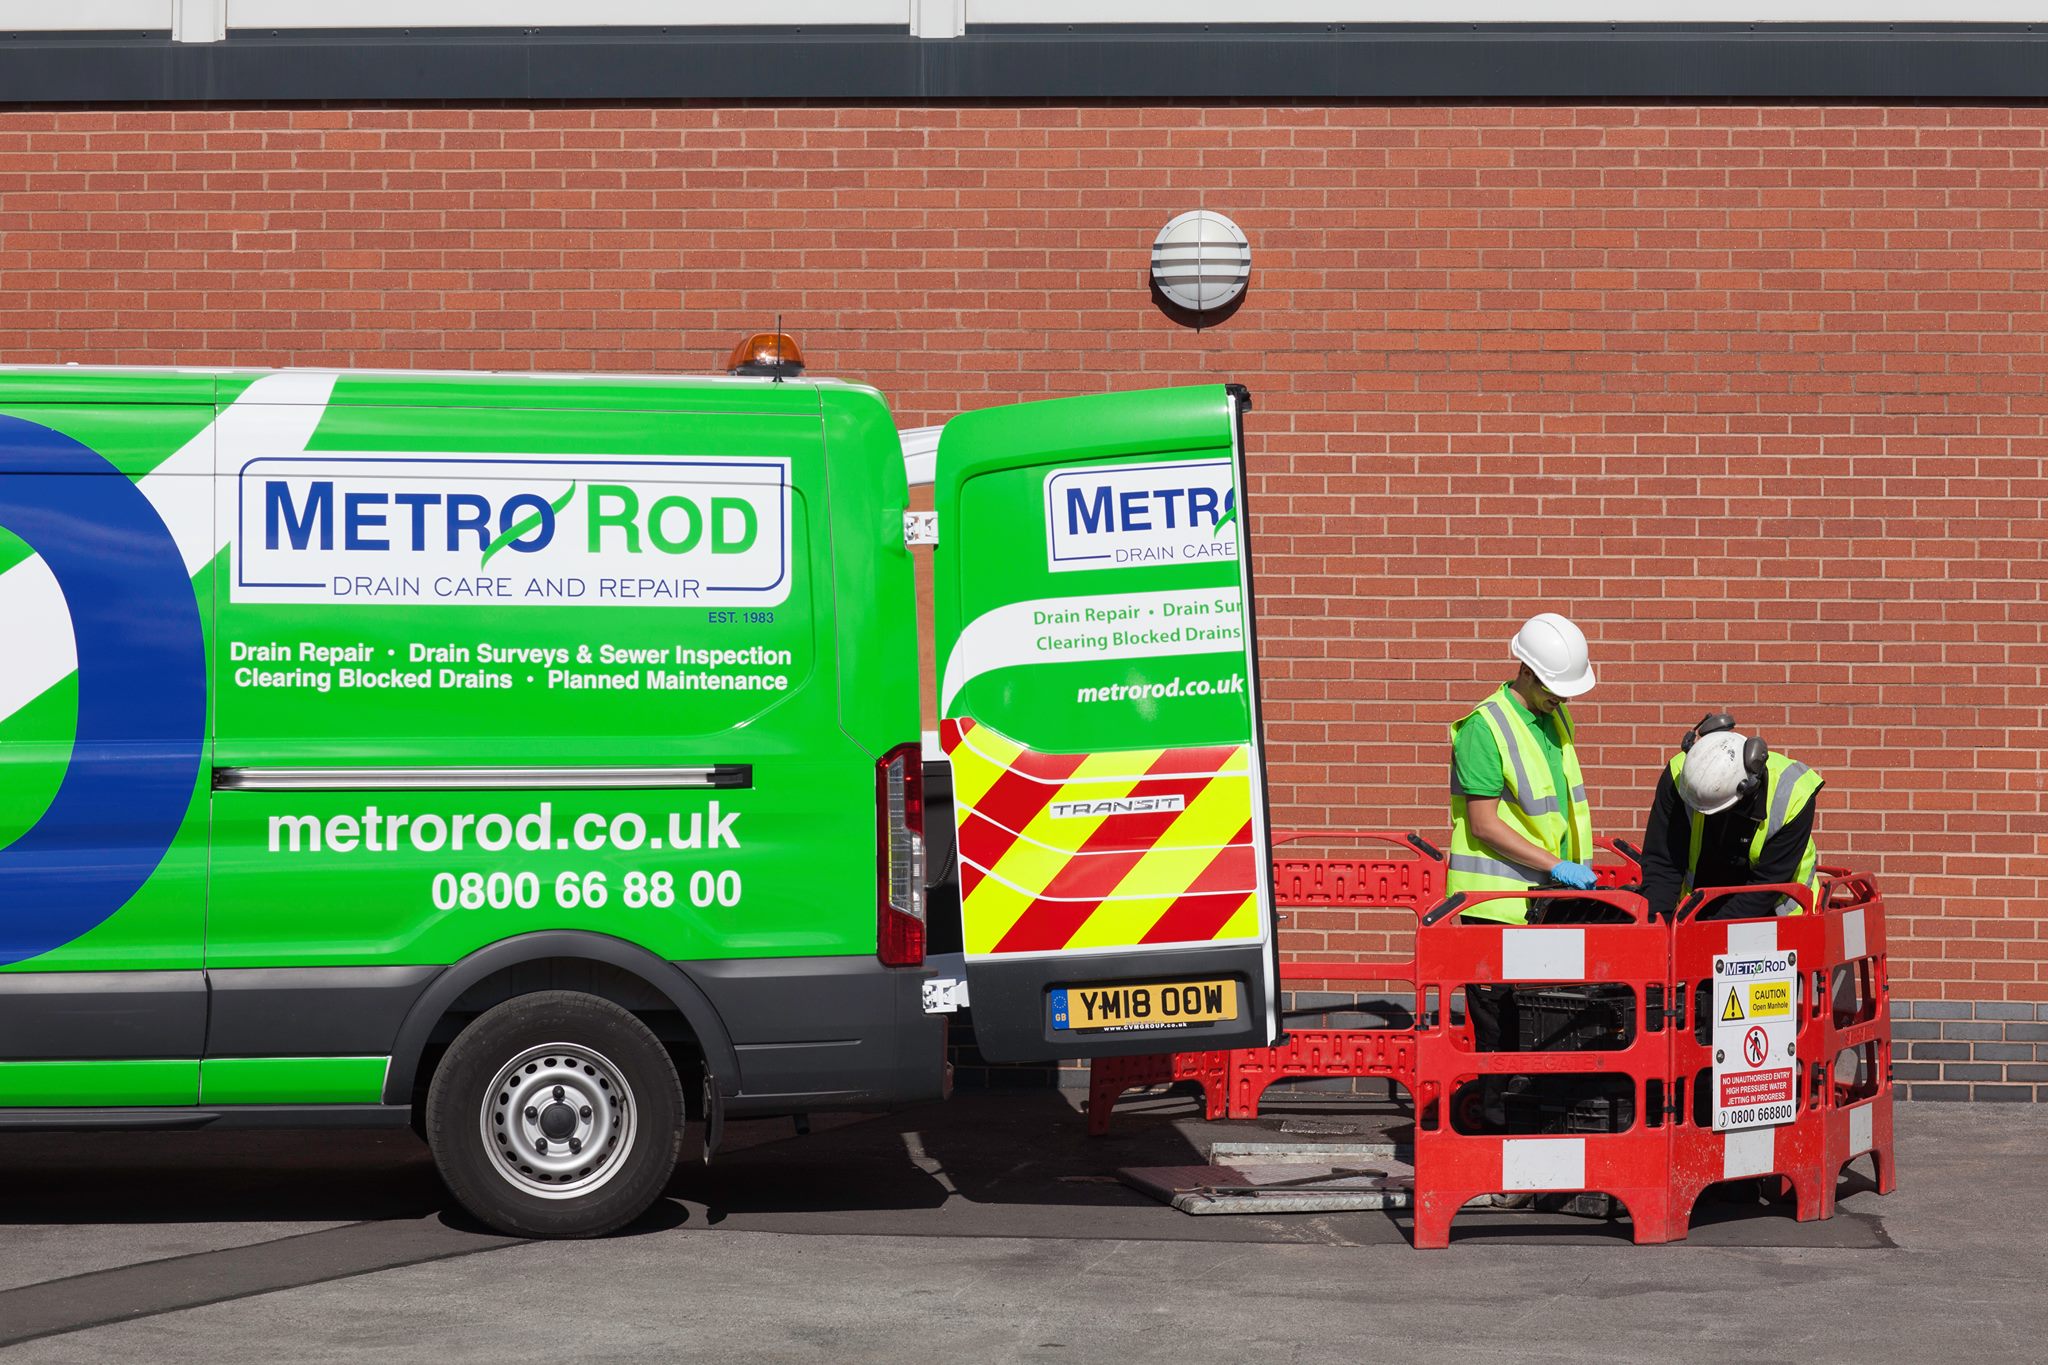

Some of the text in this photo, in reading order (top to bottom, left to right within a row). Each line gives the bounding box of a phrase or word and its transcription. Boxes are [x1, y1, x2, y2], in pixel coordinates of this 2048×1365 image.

[264, 480, 758, 554] METRO ROD
[1115, 542, 1236, 563] DRAIN CARE
[332, 577, 700, 599] DRAIN CARE AND REPAIR
[708, 611, 774, 624] EST. 1983
[1033, 610, 1080, 626] Drain
[1085, 606, 1140, 623] Repair
[1163, 603, 1210, 618] Drain
[1036, 626, 1241, 651] Clearing Blocked Drains
[230, 642, 792, 671] Drain Repair Drain Surveys & Sewer Inspection
[234, 667, 788, 693] Clearing Blocked Drains Planned Maintenance
[1077, 674, 1245, 703] metrorod.co.uk
[1053, 797, 1180, 816] TRANSIT
[267, 801, 741, 852] metrorod.co.uk
[432, 869, 742, 910] 0800 66 88 00
[1725, 960, 1786, 976] METRO ROD
[1080, 988, 1151, 1021] YM18
[1755, 989, 1786, 1000] CAUTION
[1752, 1002, 1788, 1011] Open Manhole
[1055, 1013, 1067, 1022] GB
[1732, 1074, 1773, 1084] UNAUTHORISED
[1774, 1071, 1790, 1080] ENTRY
[1741, 1083, 1768, 1094] PRESSURE
[1769, 1081, 1787, 1090] WATER
[1727, 1092, 1785, 1105] JETTING IN PROGRESS
[1731, 1105, 1792, 1124] 0800 668800
